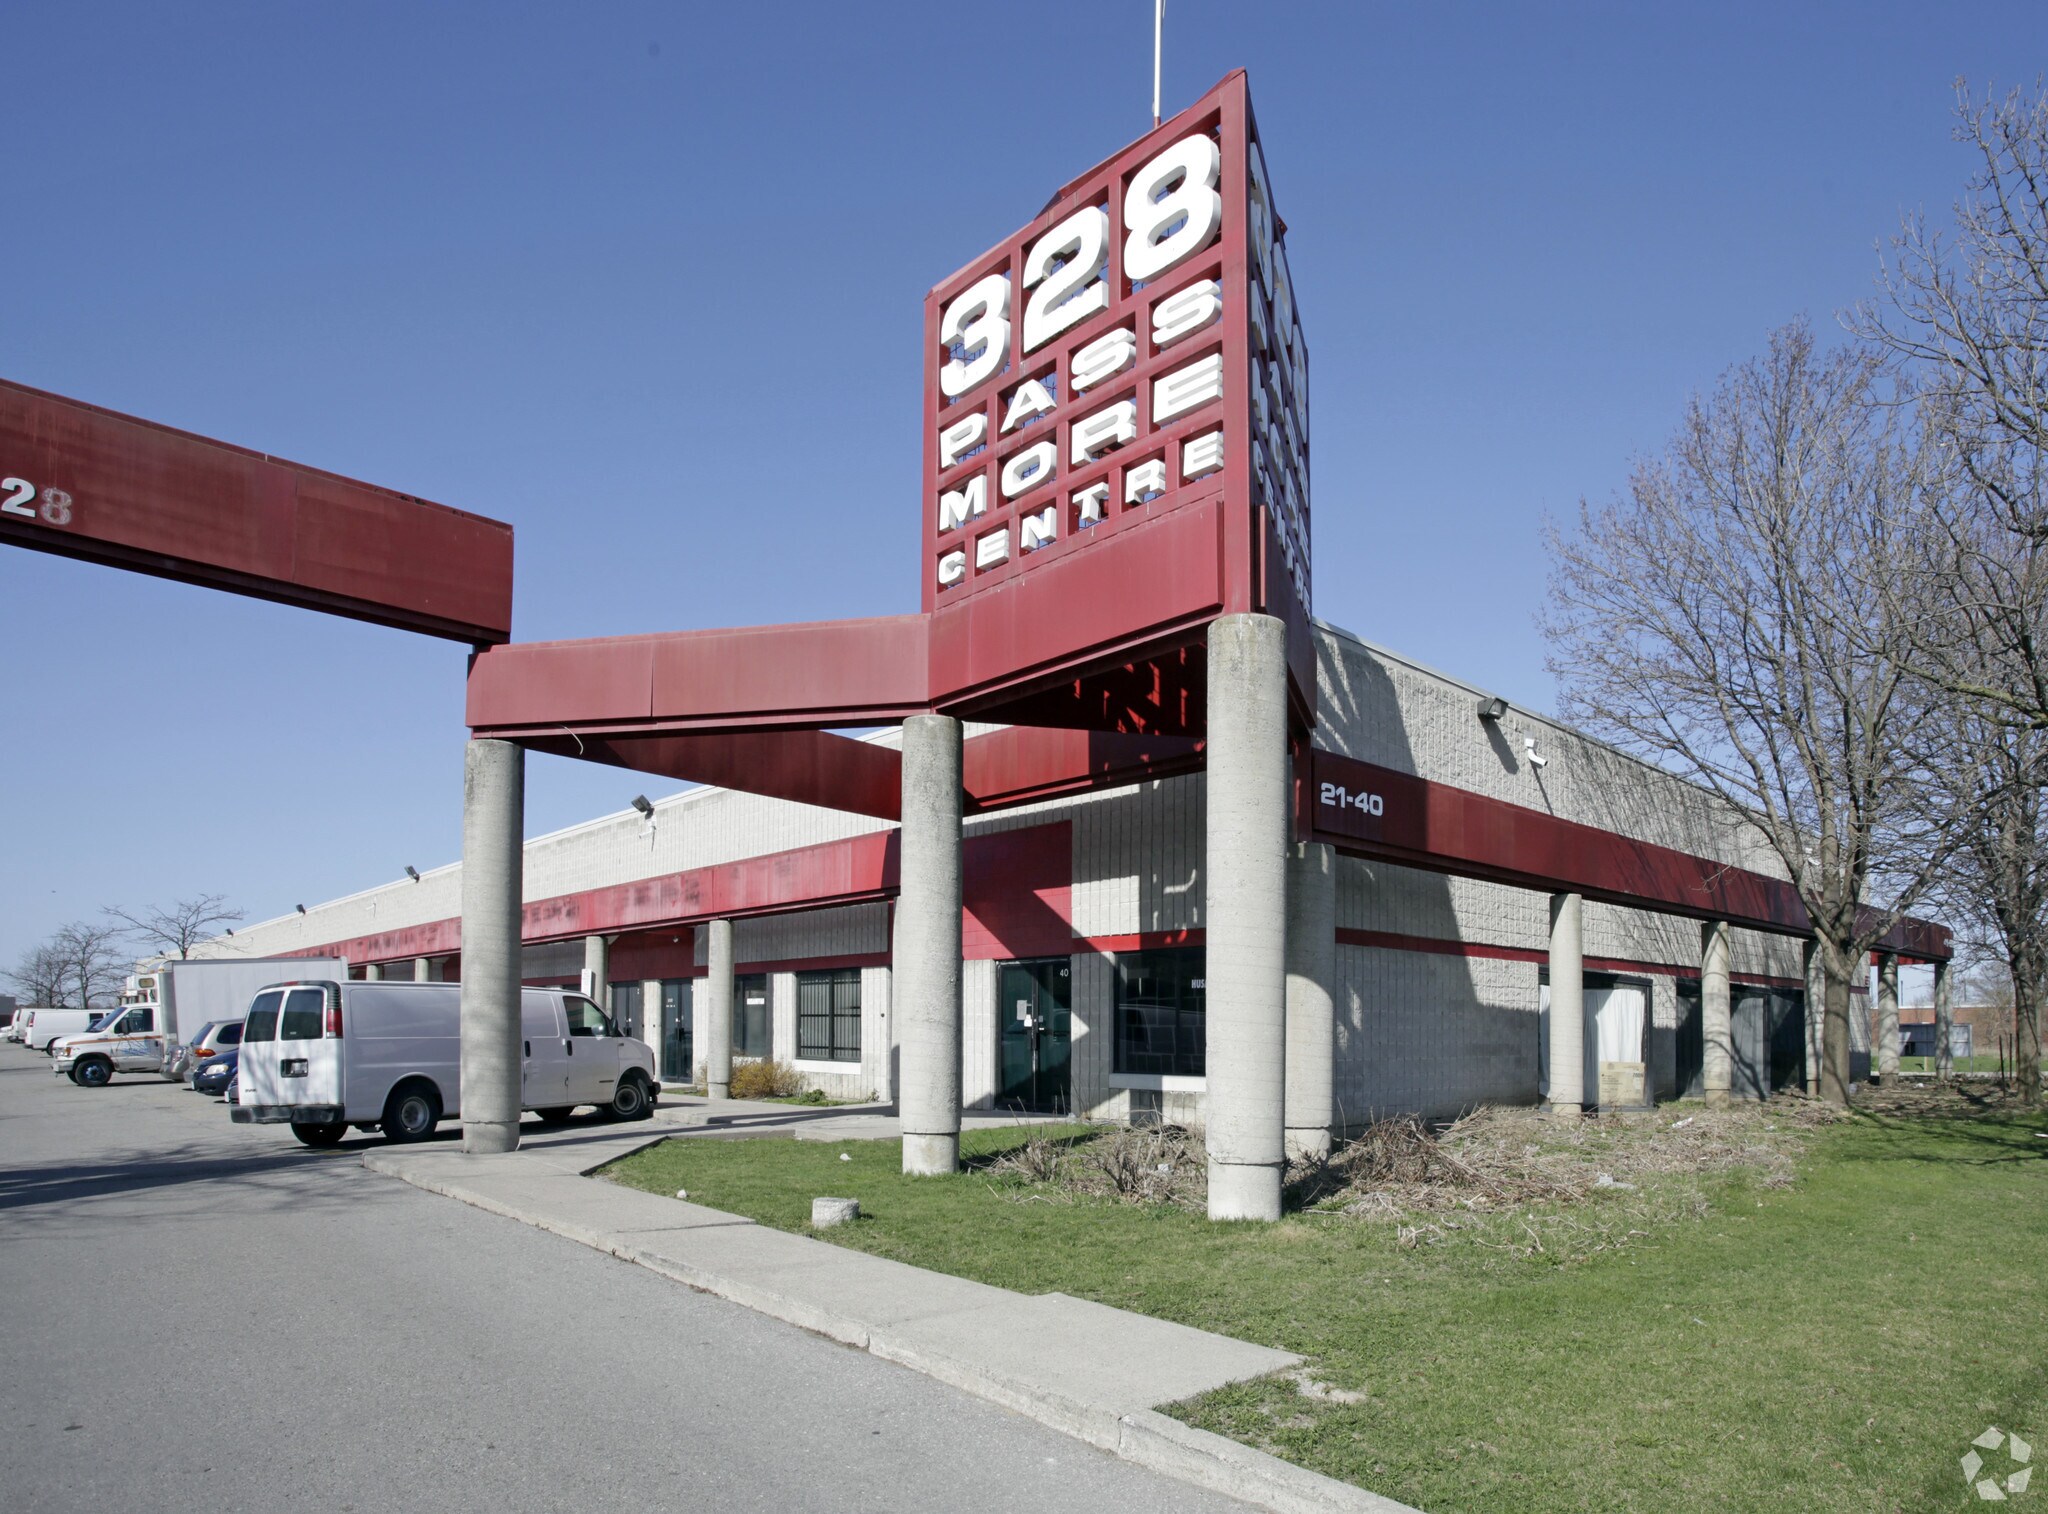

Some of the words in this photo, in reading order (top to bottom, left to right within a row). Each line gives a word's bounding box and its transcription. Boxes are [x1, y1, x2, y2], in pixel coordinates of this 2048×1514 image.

[940, 133, 1222, 397] 328
[939, 353, 1223, 531] MORE
[940, 279, 1223, 468] PASS
[938, 430, 1224, 586] CENTRE
[1320, 782, 1384, 817] 21-40
[1059, 968, 1070, 977] 40
